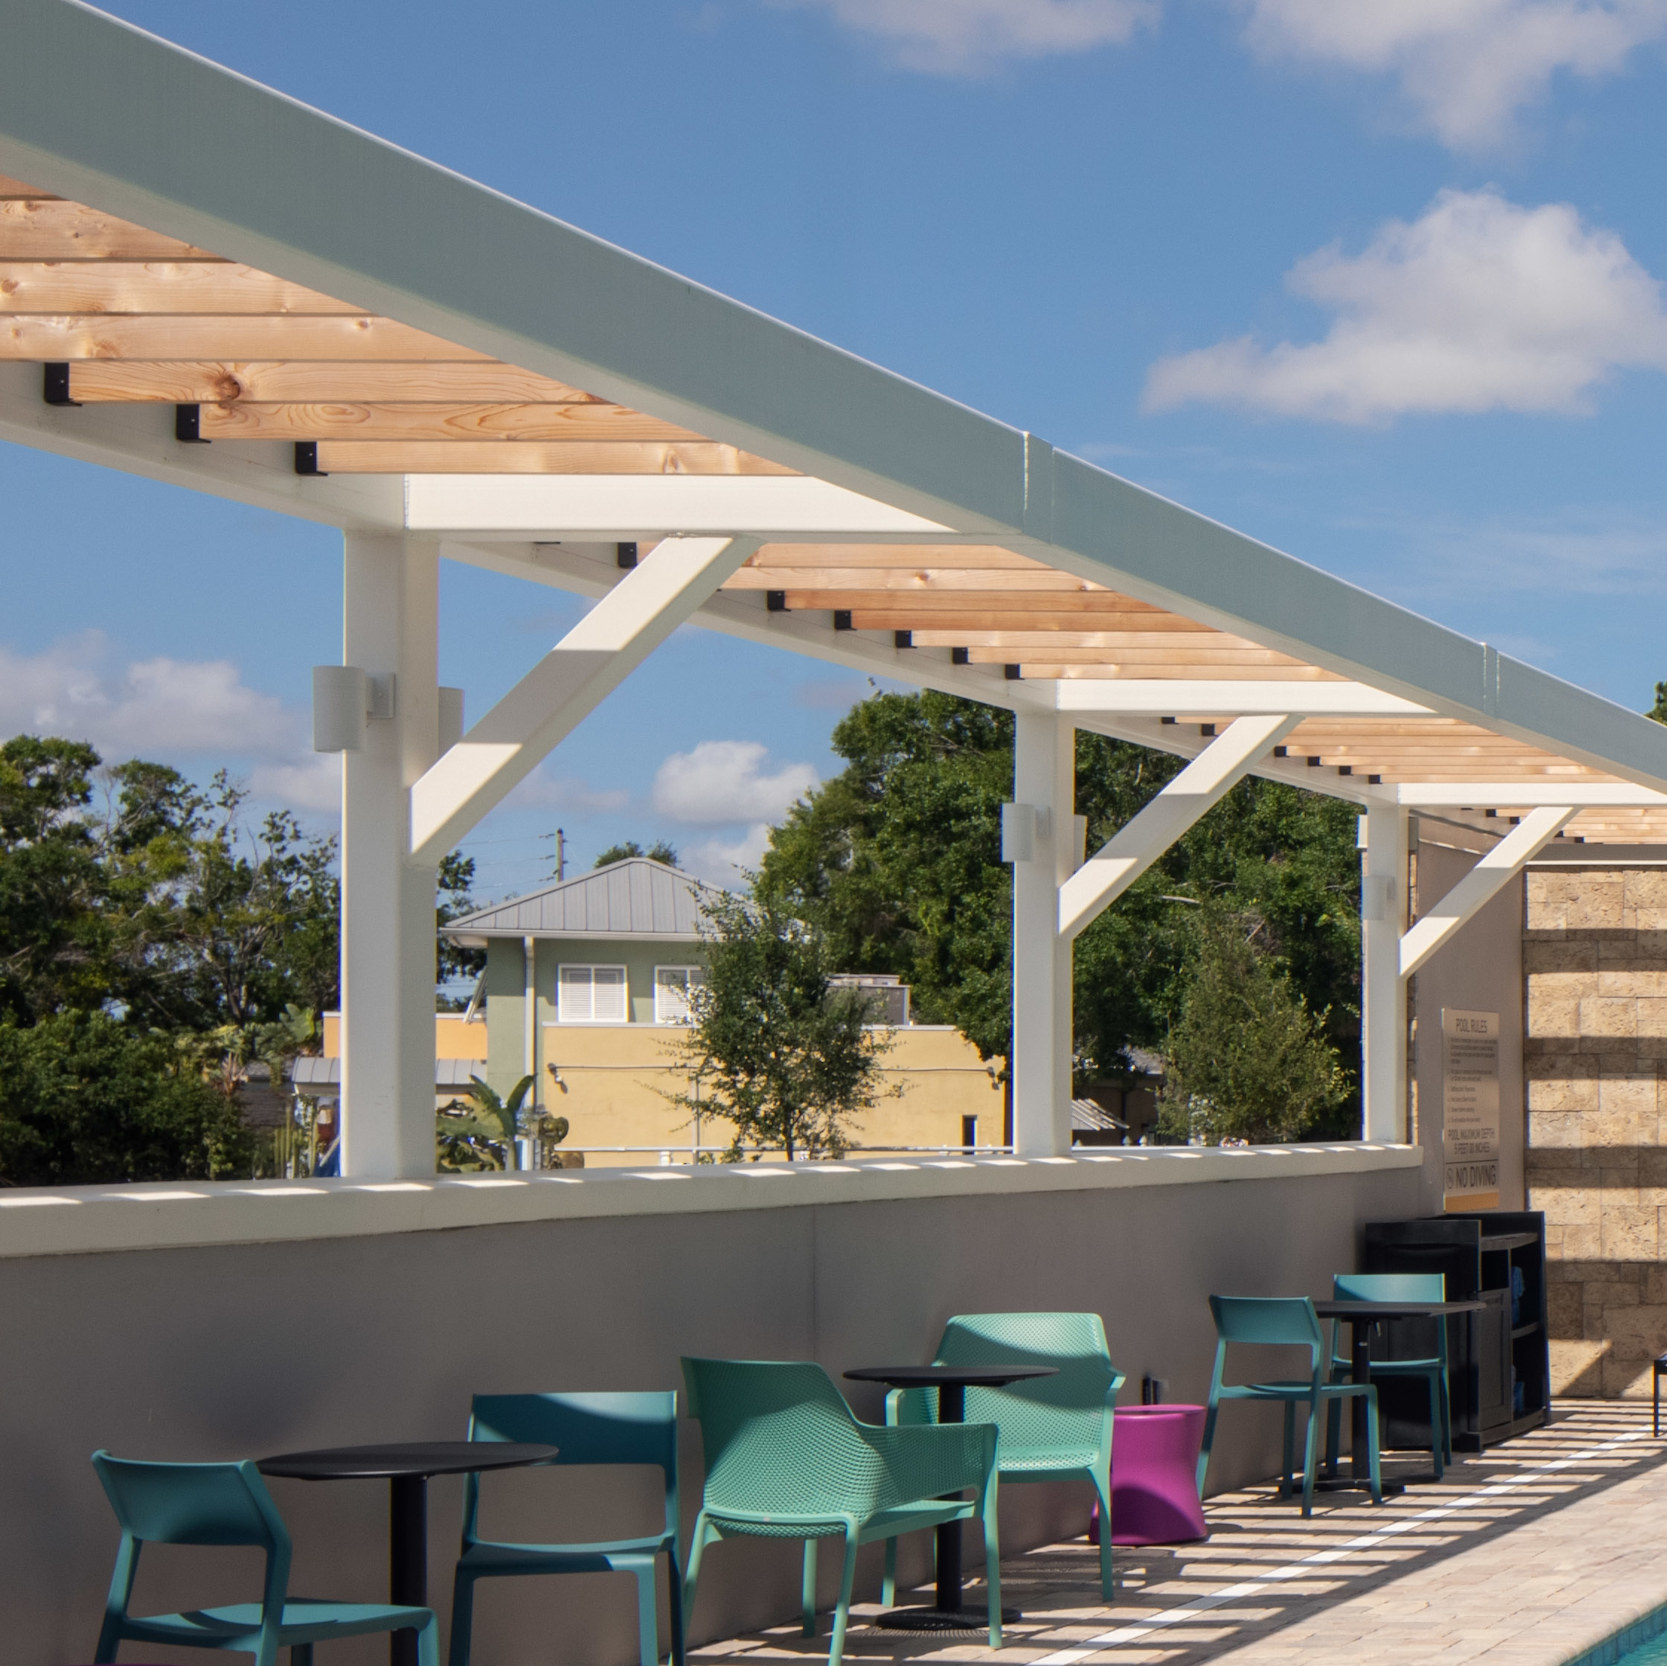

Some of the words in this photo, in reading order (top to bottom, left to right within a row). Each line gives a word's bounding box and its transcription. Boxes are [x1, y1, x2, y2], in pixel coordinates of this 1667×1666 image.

[1455, 1018, 1470, 1032] POOL
[1470, 1019, 1488, 1034] RULES
[1456, 1167, 1468, 1188] NO
[1469, 1164, 1497, 1187] DIVING
